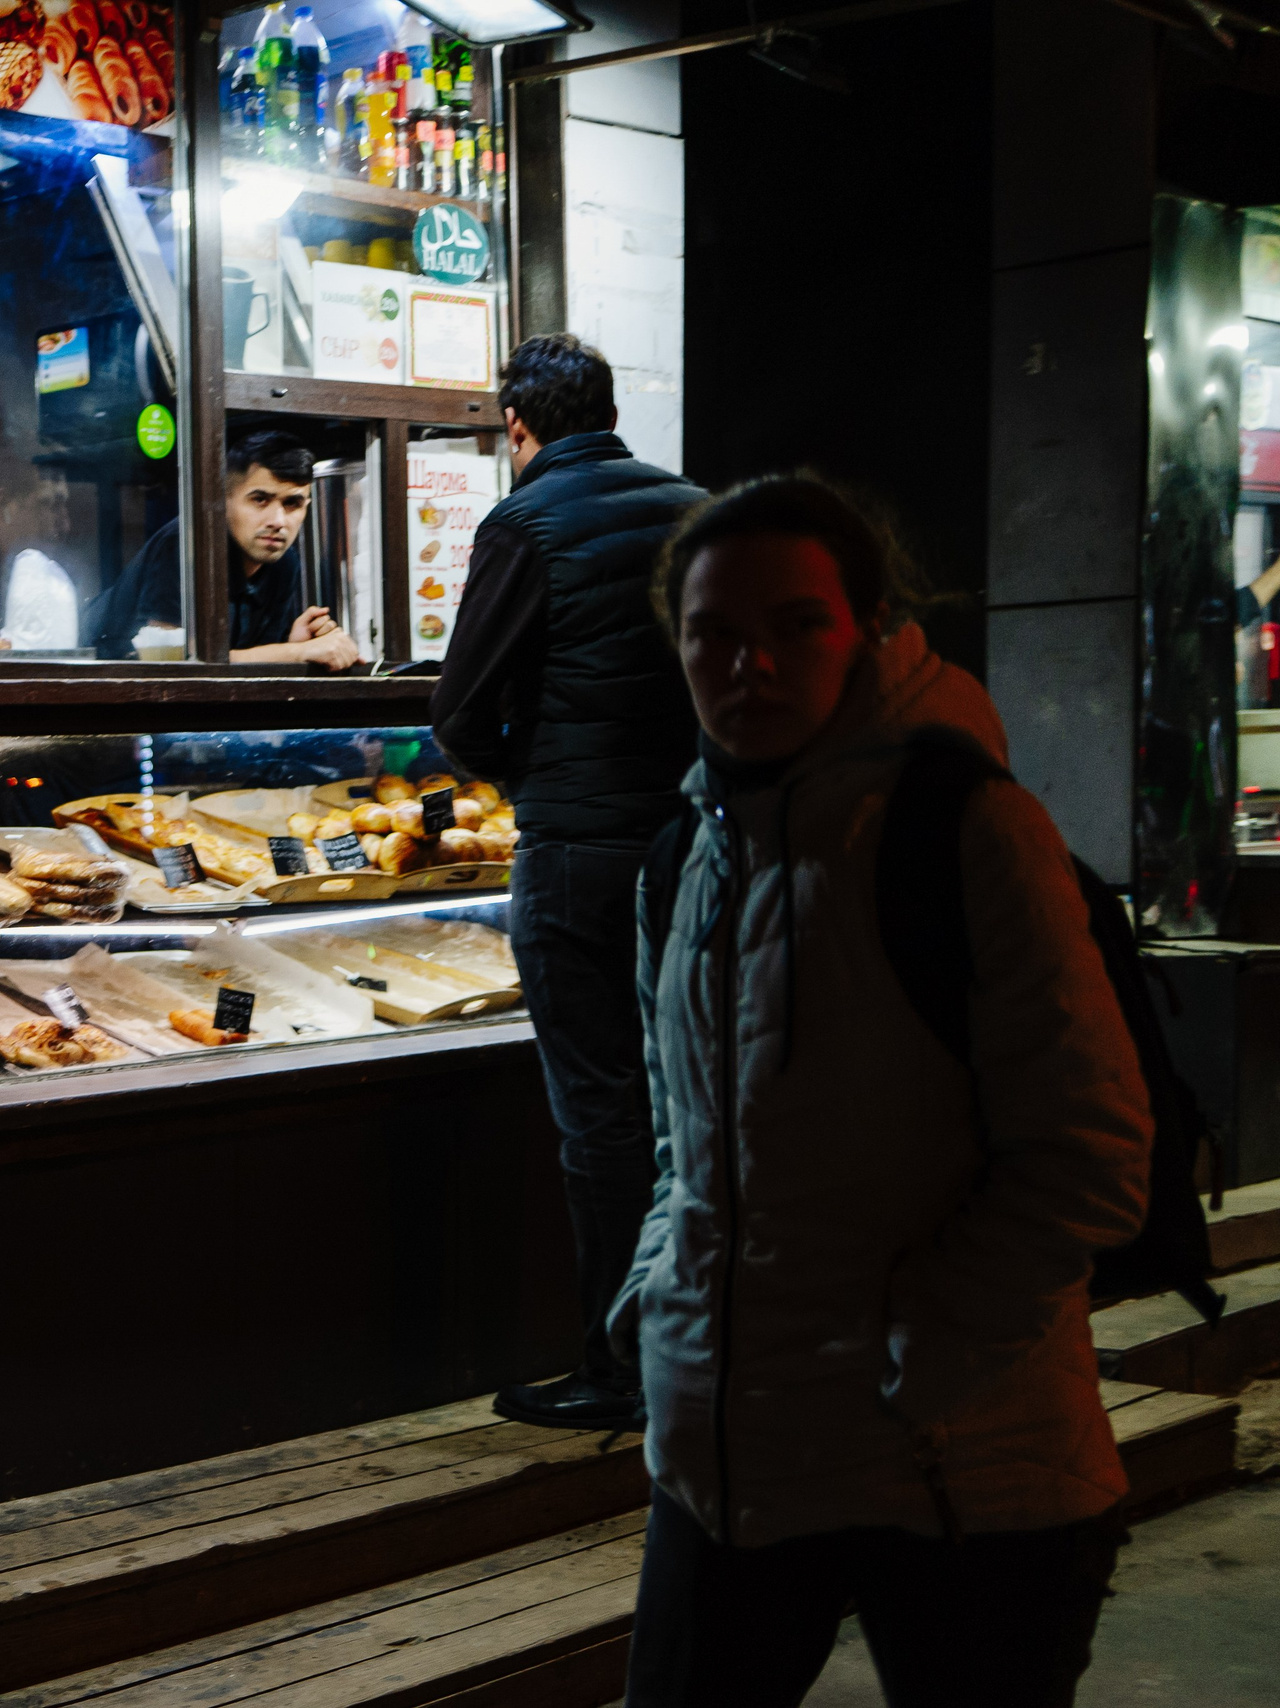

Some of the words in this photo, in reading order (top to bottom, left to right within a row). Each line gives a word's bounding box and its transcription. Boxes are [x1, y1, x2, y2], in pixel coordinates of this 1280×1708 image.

[421, 206, 482, 250] حلال
[422, 249, 481, 276] HALAL
[321, 335, 361, 359] СЫР
[407, 459, 468, 497] Шаурма
